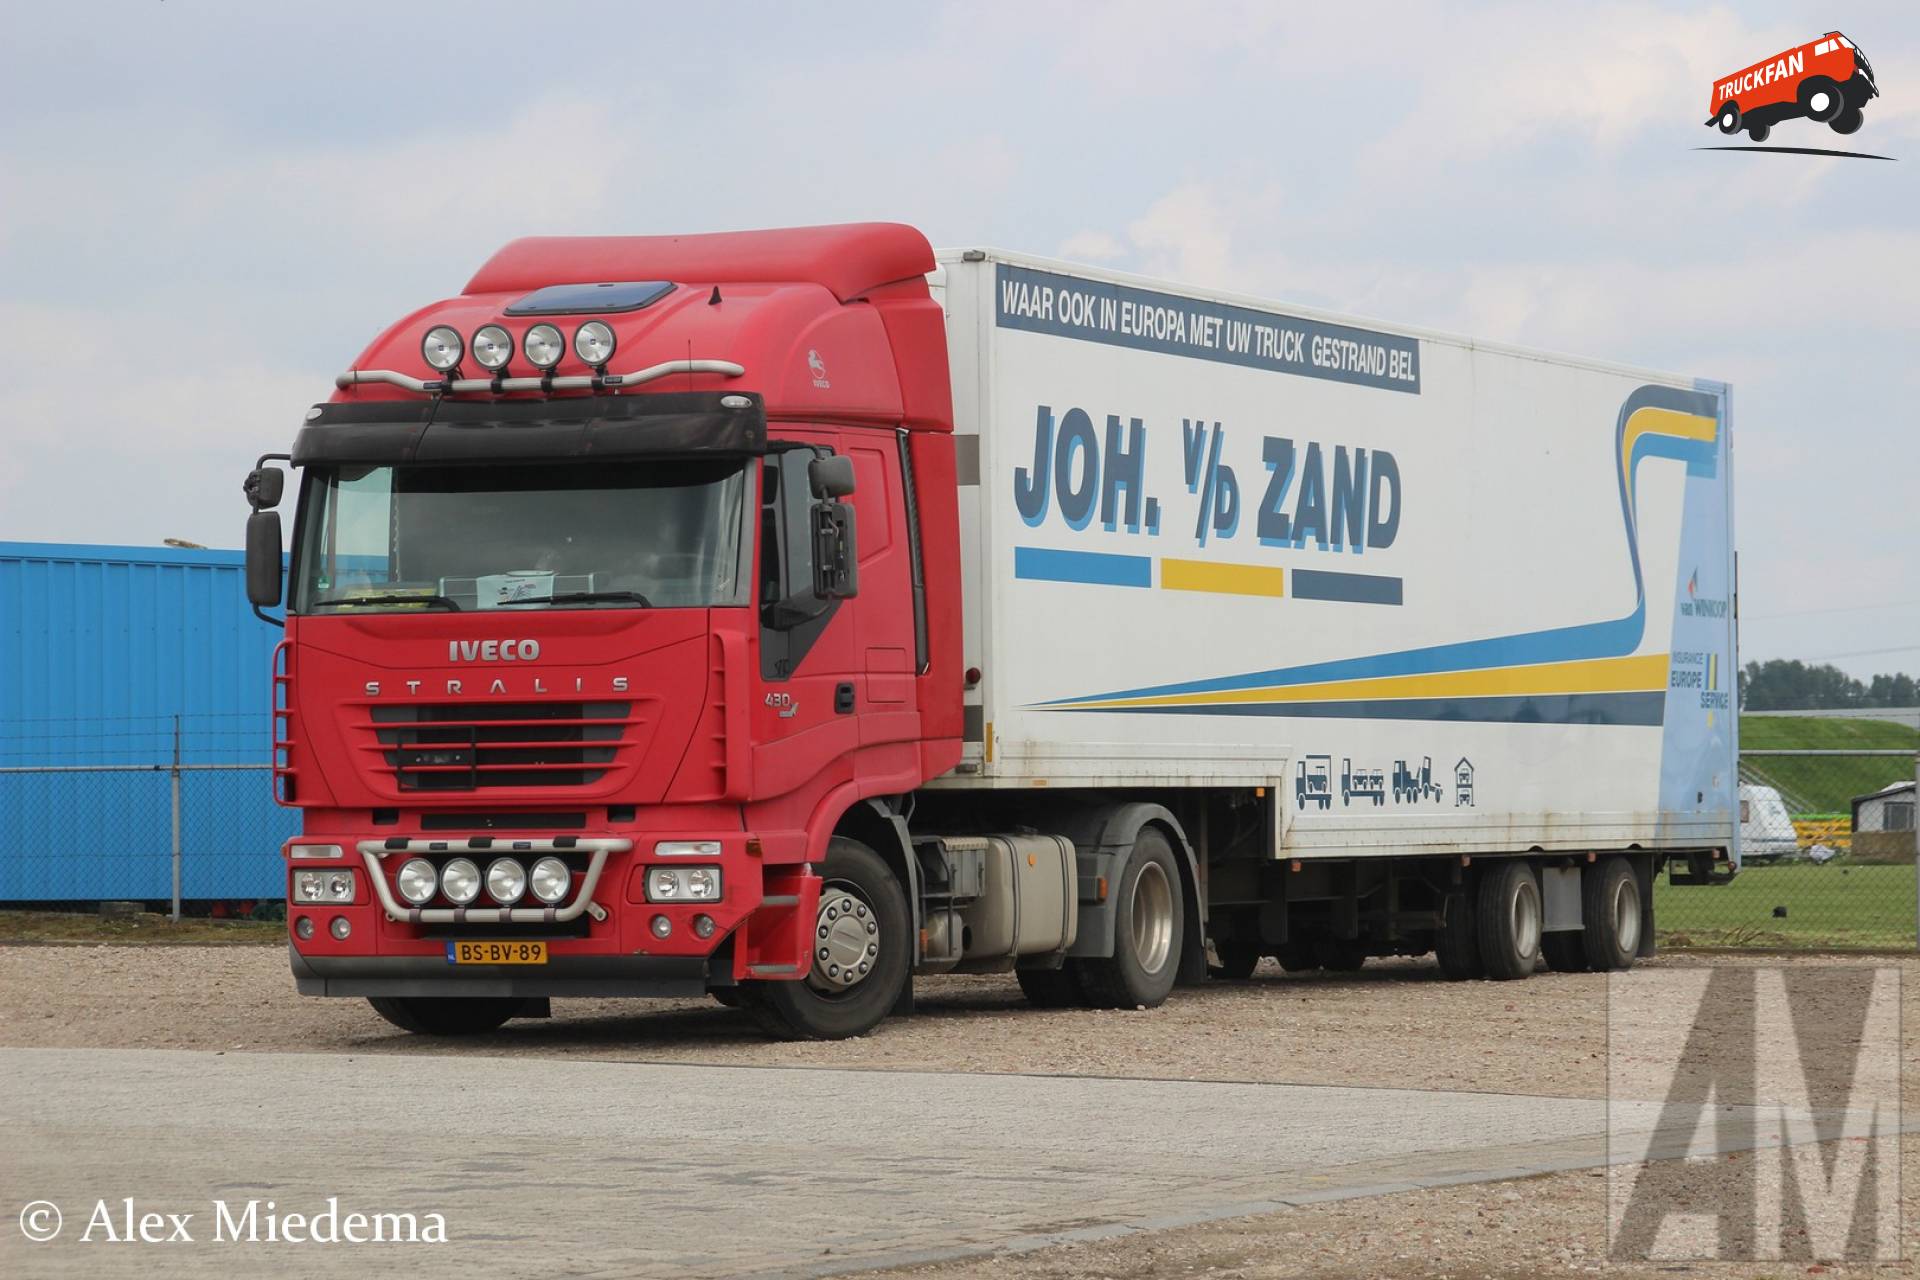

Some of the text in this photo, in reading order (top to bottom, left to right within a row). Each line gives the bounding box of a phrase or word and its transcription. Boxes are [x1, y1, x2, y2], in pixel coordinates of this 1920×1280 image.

[1001, 280, 1416, 382] WAAR OOK IN EUROPA MET UW TRUCK GESTRAND BEL
[1014, 404, 1161, 536] JOH.
[1256, 435, 1402, 555] ZAND
[449, 639, 541, 662] IVECO
[365, 676, 630, 696] STRALIS
[1670, 670, 1703, 689] EUROPE
[764, 692, 791, 707] 430
[1700, 691, 1729, 710] SERVICE
[461, 944, 542, 961] BS-BV-89
